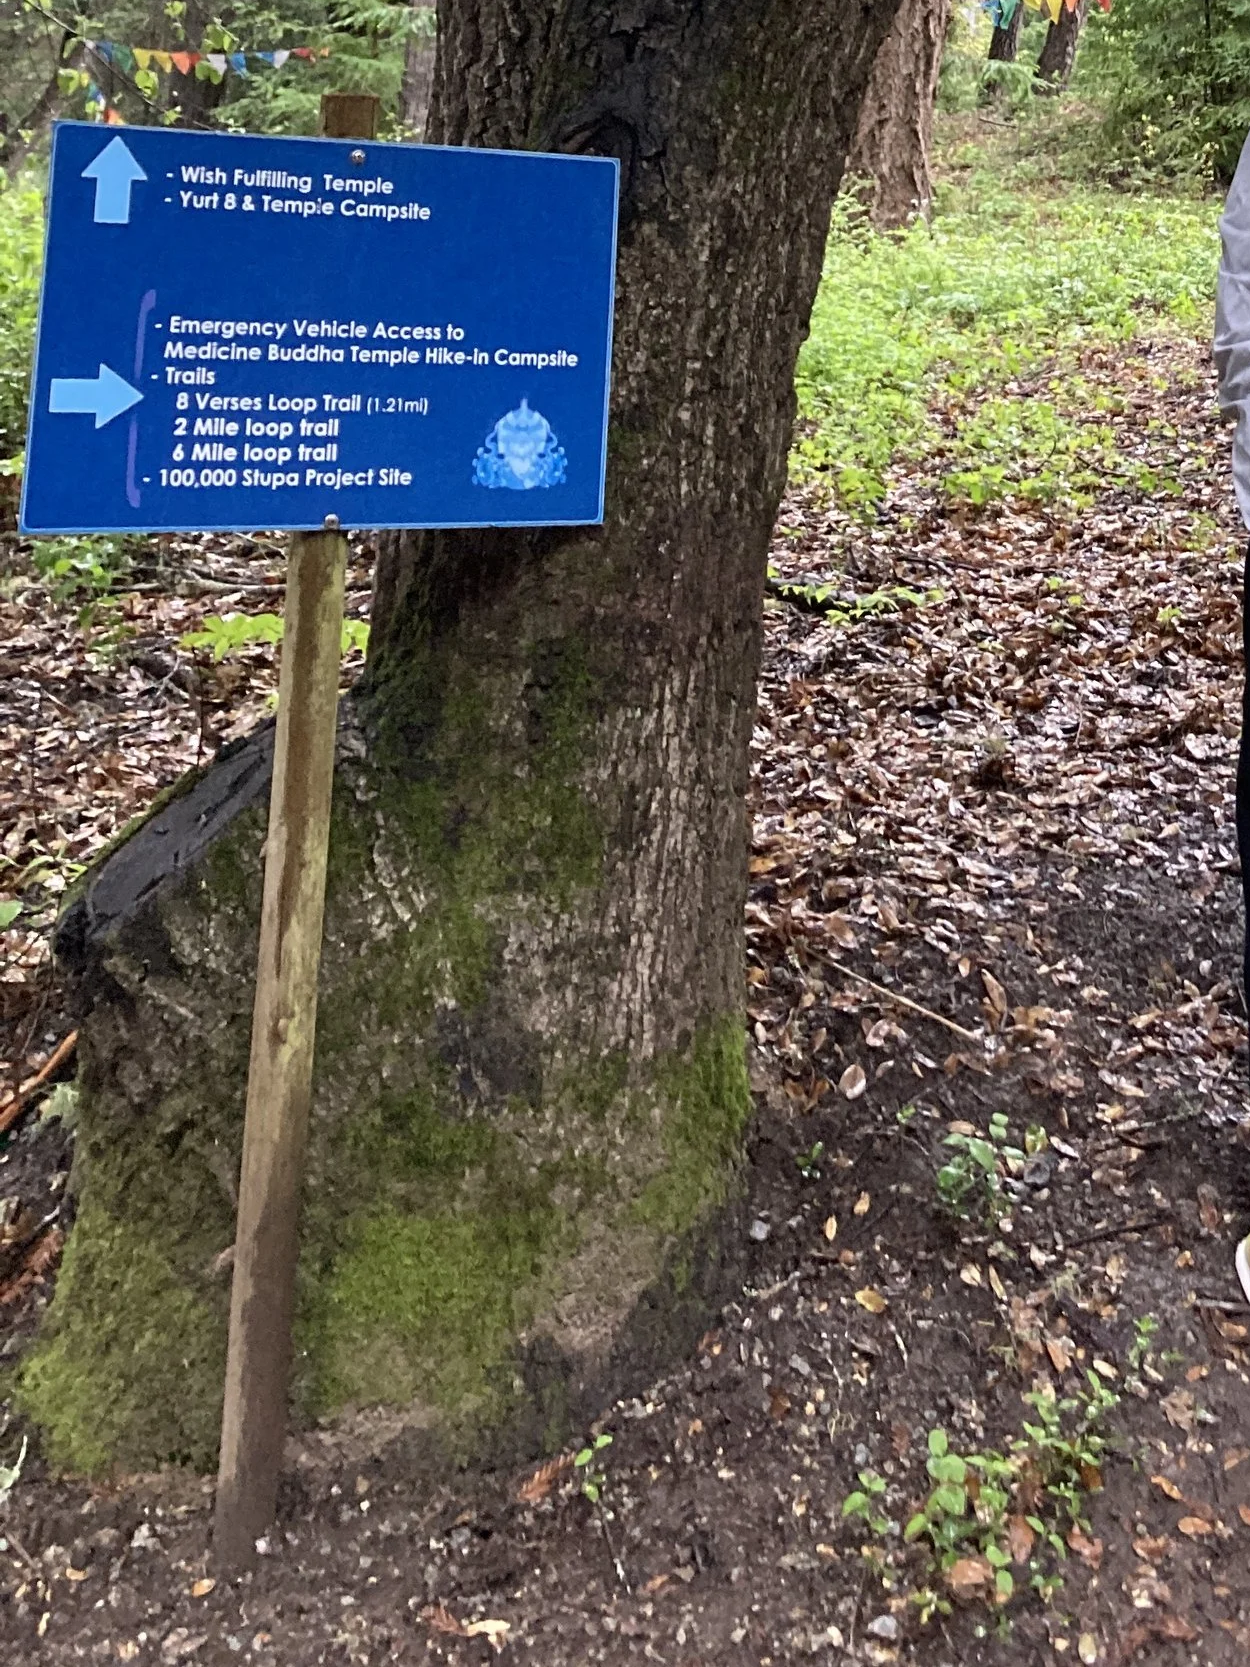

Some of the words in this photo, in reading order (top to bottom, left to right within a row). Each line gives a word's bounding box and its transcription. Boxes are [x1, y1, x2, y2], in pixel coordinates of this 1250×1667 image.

[180, 165, 227, 185] Wish
[233, 168, 312, 194] Fulfilling
[323, 173, 394, 197] Temple
[179, 190, 219, 209] Yurt
[223, 192, 237, 210] 8
[241, 194, 255, 211] &
[261, 194, 334, 218] Temple
[340, 198, 431, 222] Campsite
[169, 315, 288, 340] Emergency
[292, 319, 368, 339] Vehicle
[372, 321, 442, 341] Access
[446, 323, 465, 341] to
[163, 341, 262, 361] Medicine
[267, 343, 345, 363] Buddha
[349, 345, 420, 367] Temple
[425, 347, 489, 366] Hike-in
[494, 348, 578, 370] Campsite
[165, 366, 216, 385] Trails
[175, 391, 189, 410] 8
[195, 392, 262, 412] Verses
[268, 393, 318, 415] Loop
[322, 394, 362, 413] Trail
[366, 397, 429, 416] (1.21mi)
[173, 417, 188, 436] 2
[192, 417, 240, 437] Mile
[245, 417, 294, 441] loop
[299, 418, 340, 437] trail
[172, 443, 185, 462] 6
[190, 442, 238, 462] Mile
[243, 442, 292, 466] loop
[297, 443, 338, 463] trail
[159, 468, 237, 488] 100,000
[241, 468, 300, 491] Stupa
[305, 468, 375, 491] Project
[378, 468, 413, 486] Site
